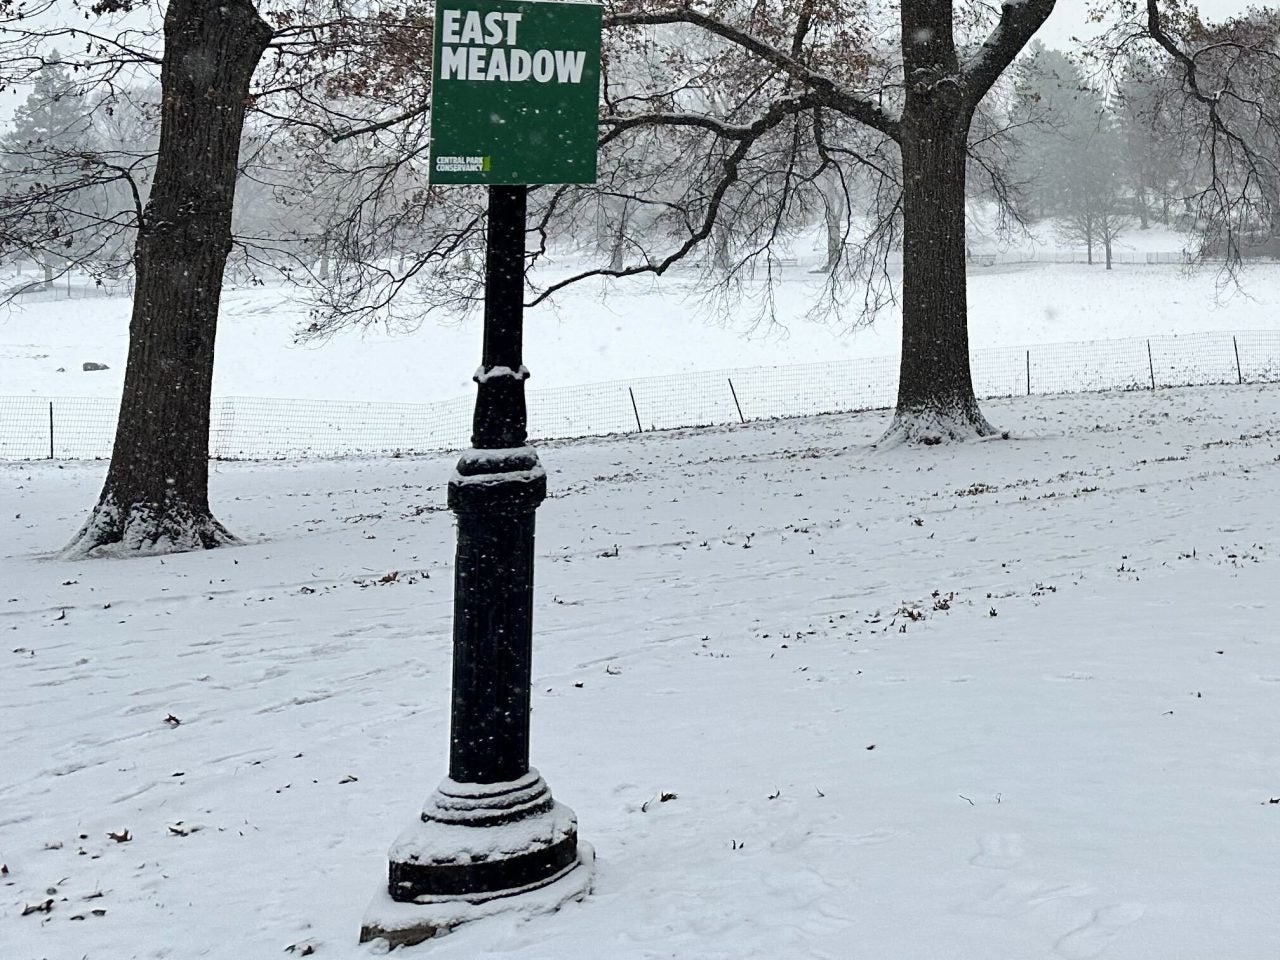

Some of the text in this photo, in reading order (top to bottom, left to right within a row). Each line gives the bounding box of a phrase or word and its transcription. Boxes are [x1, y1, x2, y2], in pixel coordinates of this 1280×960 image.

[442, 9, 523, 46] EAST
[440, 46, 587, 84] MEADOW
[436, 156, 484, 164] CENTRAL PARK
[436, 164, 484, 172] CONSERVANCY
